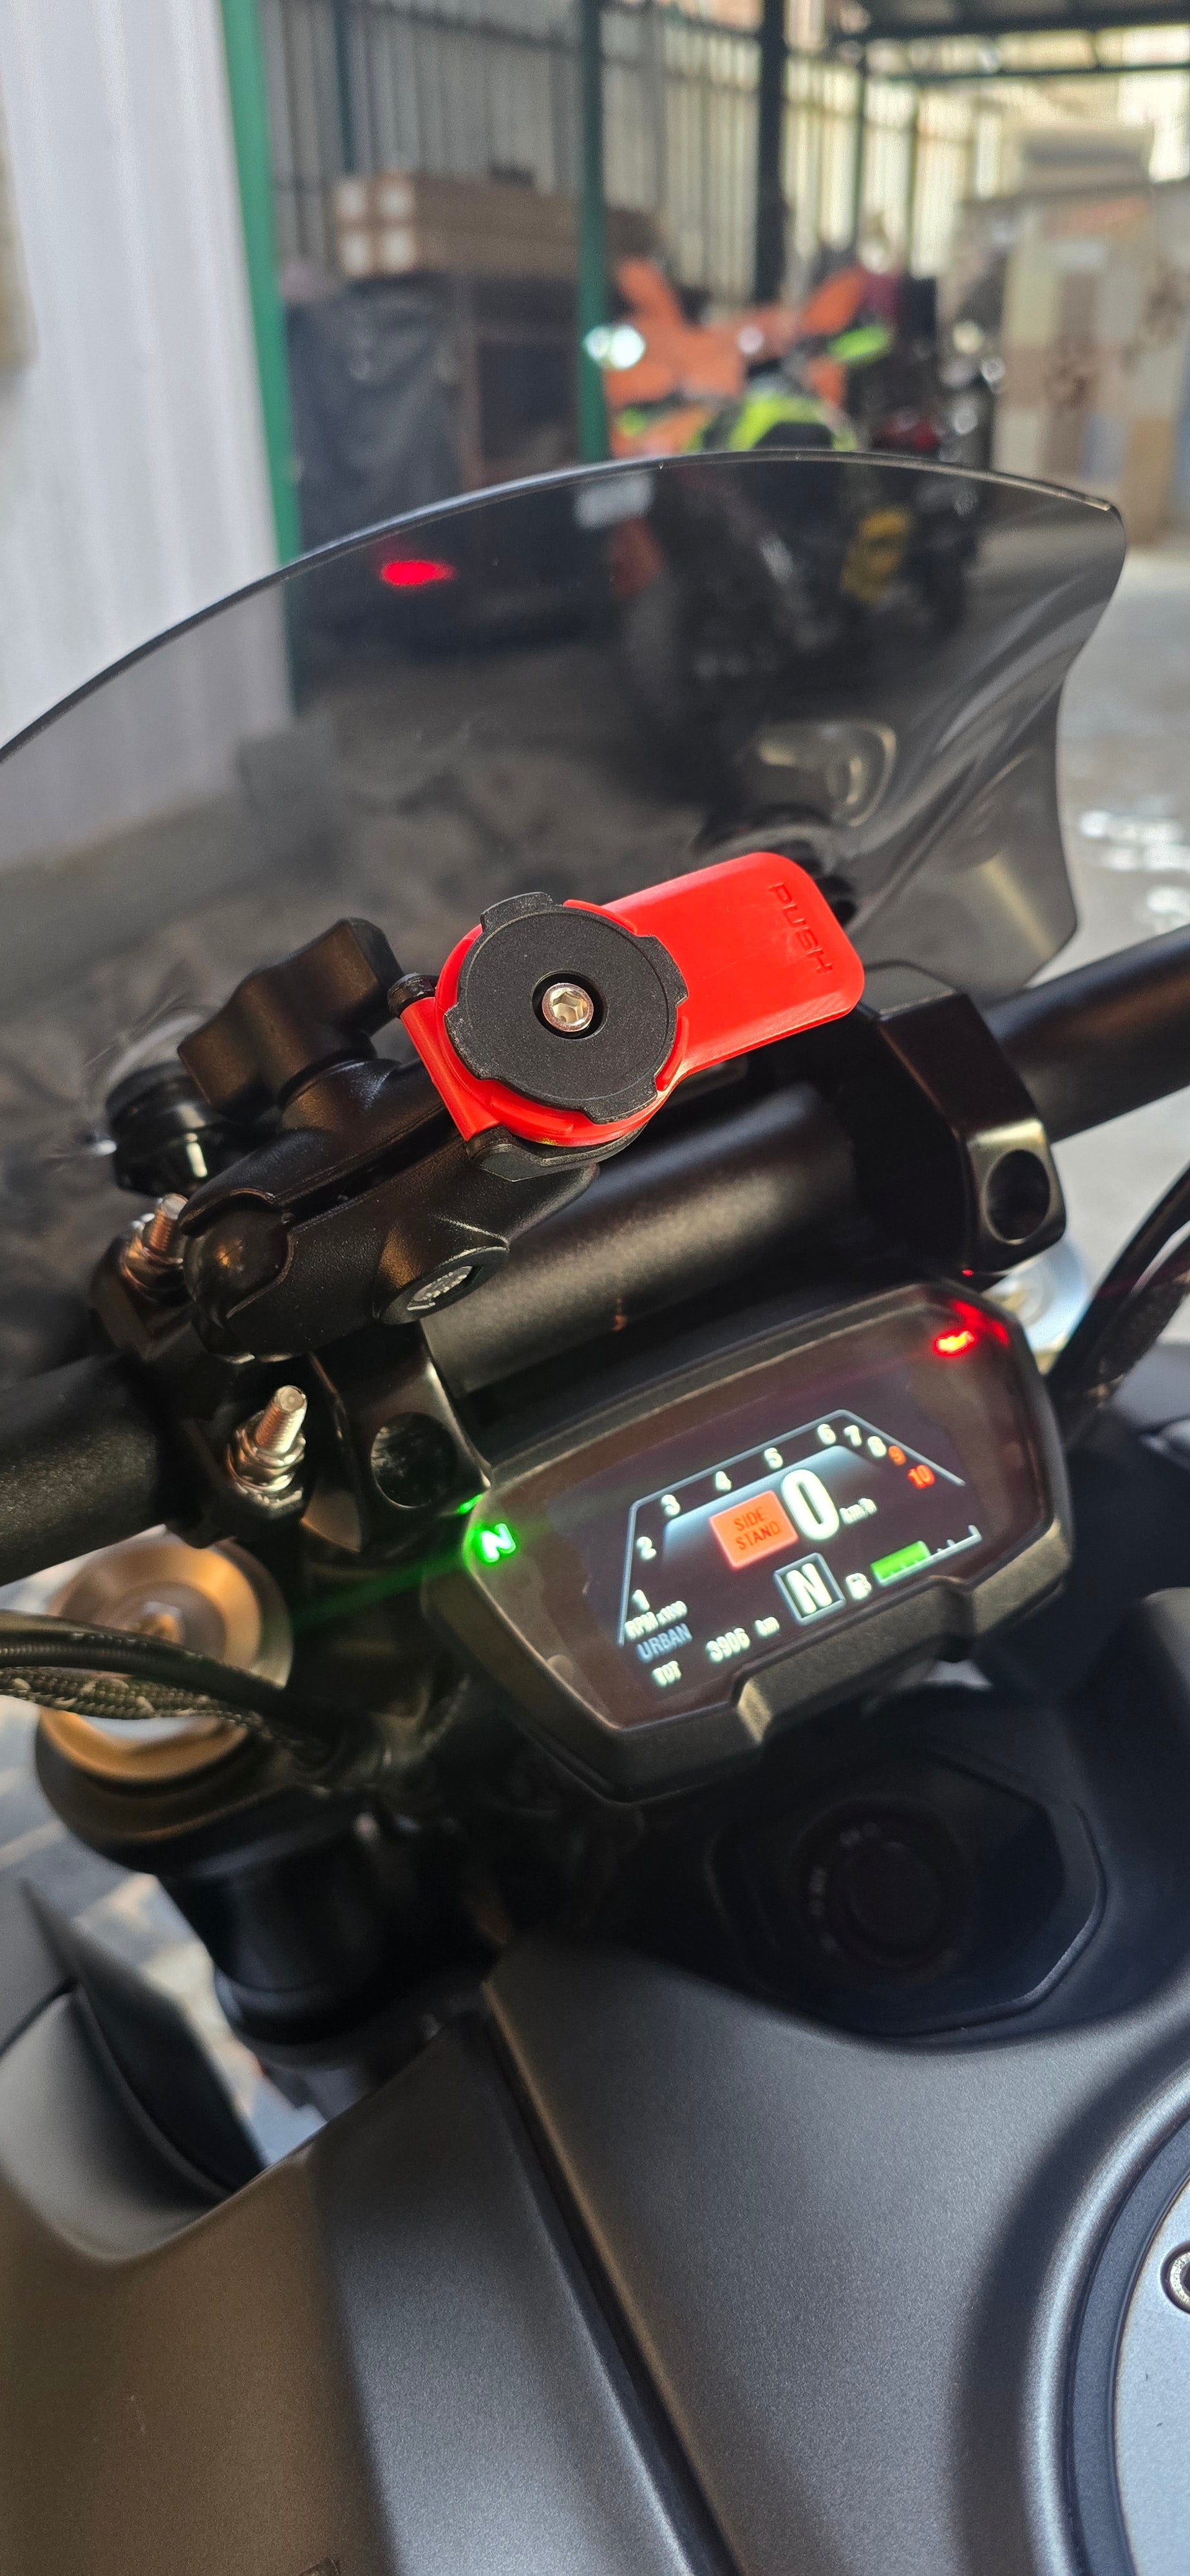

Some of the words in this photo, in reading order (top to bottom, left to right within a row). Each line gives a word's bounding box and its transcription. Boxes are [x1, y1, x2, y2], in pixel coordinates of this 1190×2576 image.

[768, 882, 833, 974] PUSH
[817, 1423, 836, 1445] 6
[844, 1425, 862, 1447] 7
[867, 1435, 887, 1458] 8
[764, 1447, 783, 1469] 5
[888, 1445, 906, 1466] 9
[715, 1471, 732, 1492] 4
[907, 1464, 935, 1489] 10
[661, 1494, 681, 1516] 3
[780, 1468, 840, 1540] 0
[733, 1506, 768, 1531] SIDE
[480, 1522, 516, 1563] N
[636, 1536, 657, 1560] 2
[735, 1520, 780, 1551] STAND
[632, 1589, 650, 1611] 1
[786, 1562, 833, 1614] N
[625, 1611, 659, 1640] RPM
[636, 1622, 692, 1663] URBAN
[706, 1627, 750, 1662] 3906
